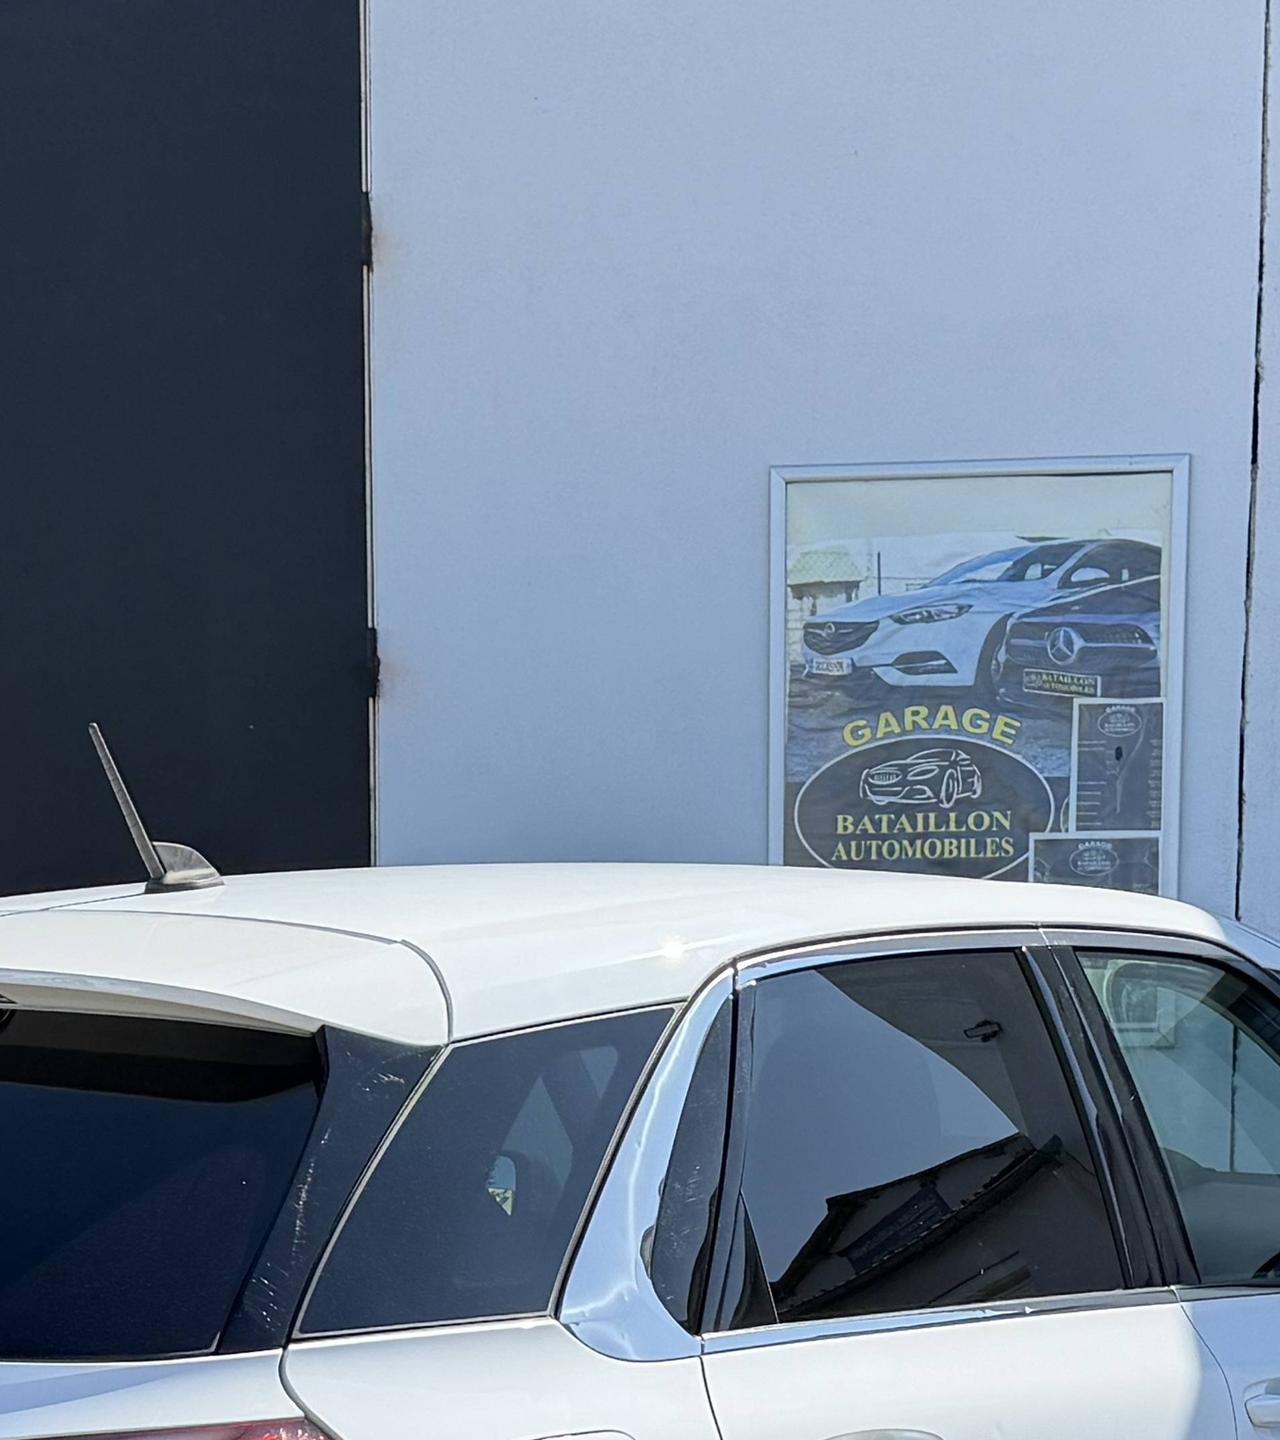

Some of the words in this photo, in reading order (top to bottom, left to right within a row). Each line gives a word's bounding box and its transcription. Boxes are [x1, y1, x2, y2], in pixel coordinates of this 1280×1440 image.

[842, 704, 1021, 747] GARAGE
[836, 810, 1012, 835] BATAILLON
[831, 836, 1014, 862] AUTOMOBILES
